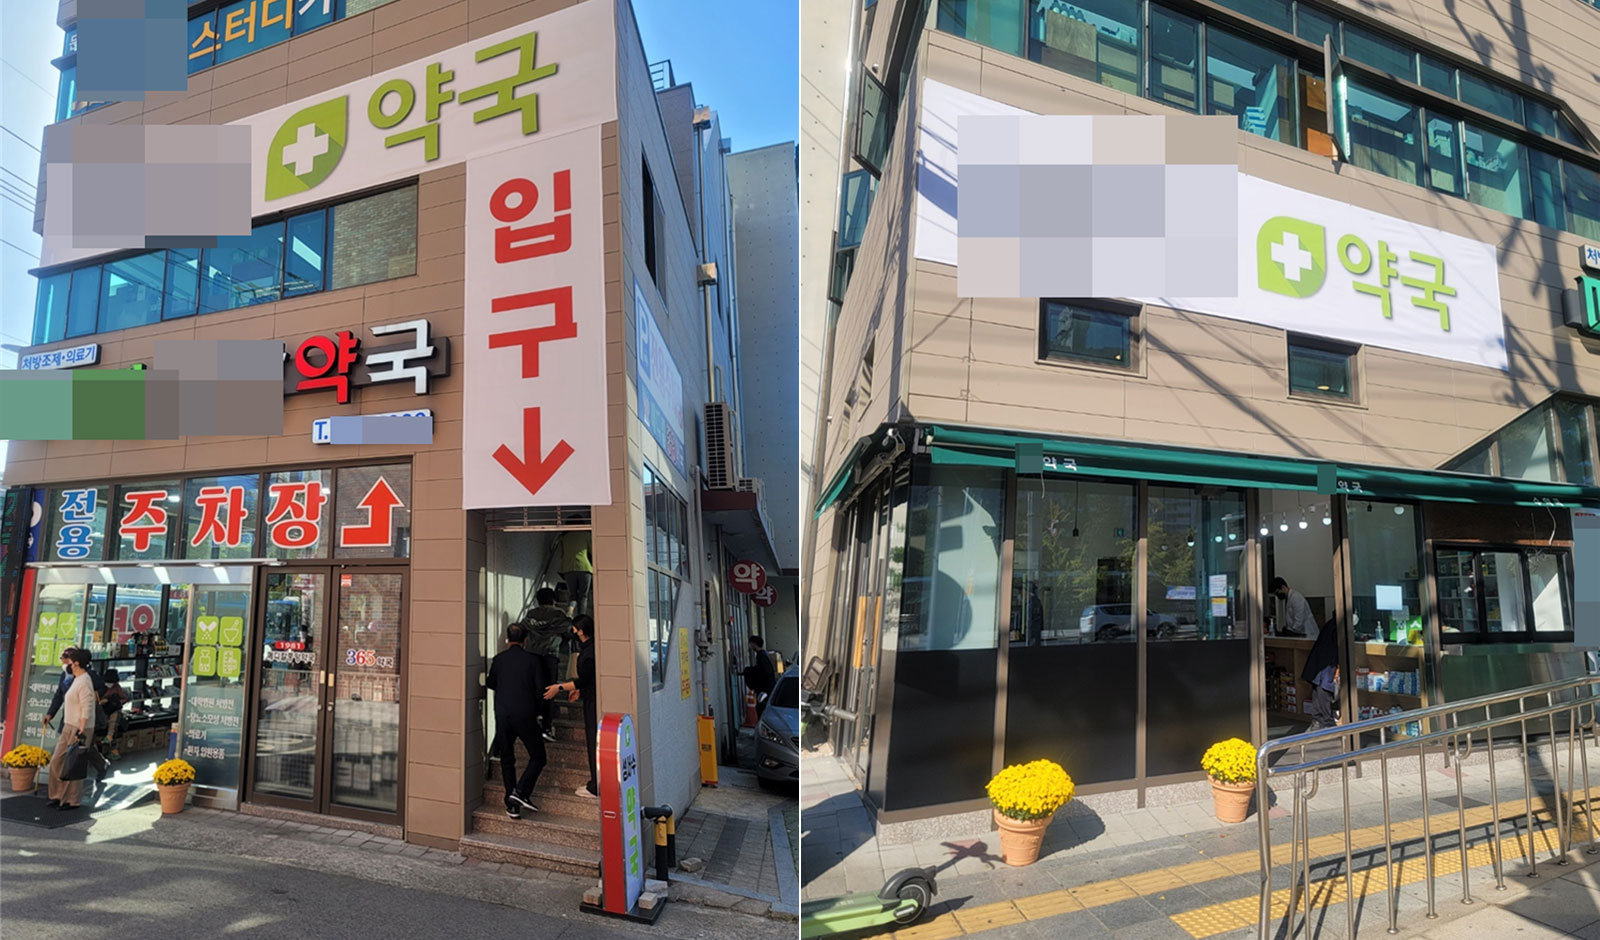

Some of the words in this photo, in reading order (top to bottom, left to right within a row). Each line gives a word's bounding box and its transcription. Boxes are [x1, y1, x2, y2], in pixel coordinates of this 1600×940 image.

[368, 31, 558, 162] 약국
[488, 169, 578, 379] 입구
[1337, 233, 1457, 332] 약국
[295, 319, 434, 404] 약국
[57, 488, 97, 560] 전용
[119, 481, 327, 552] 주차장
[733, 563, 760, 590] 약
[280, 642, 301, 650] 1981
[345, 649, 376, 667] 365
